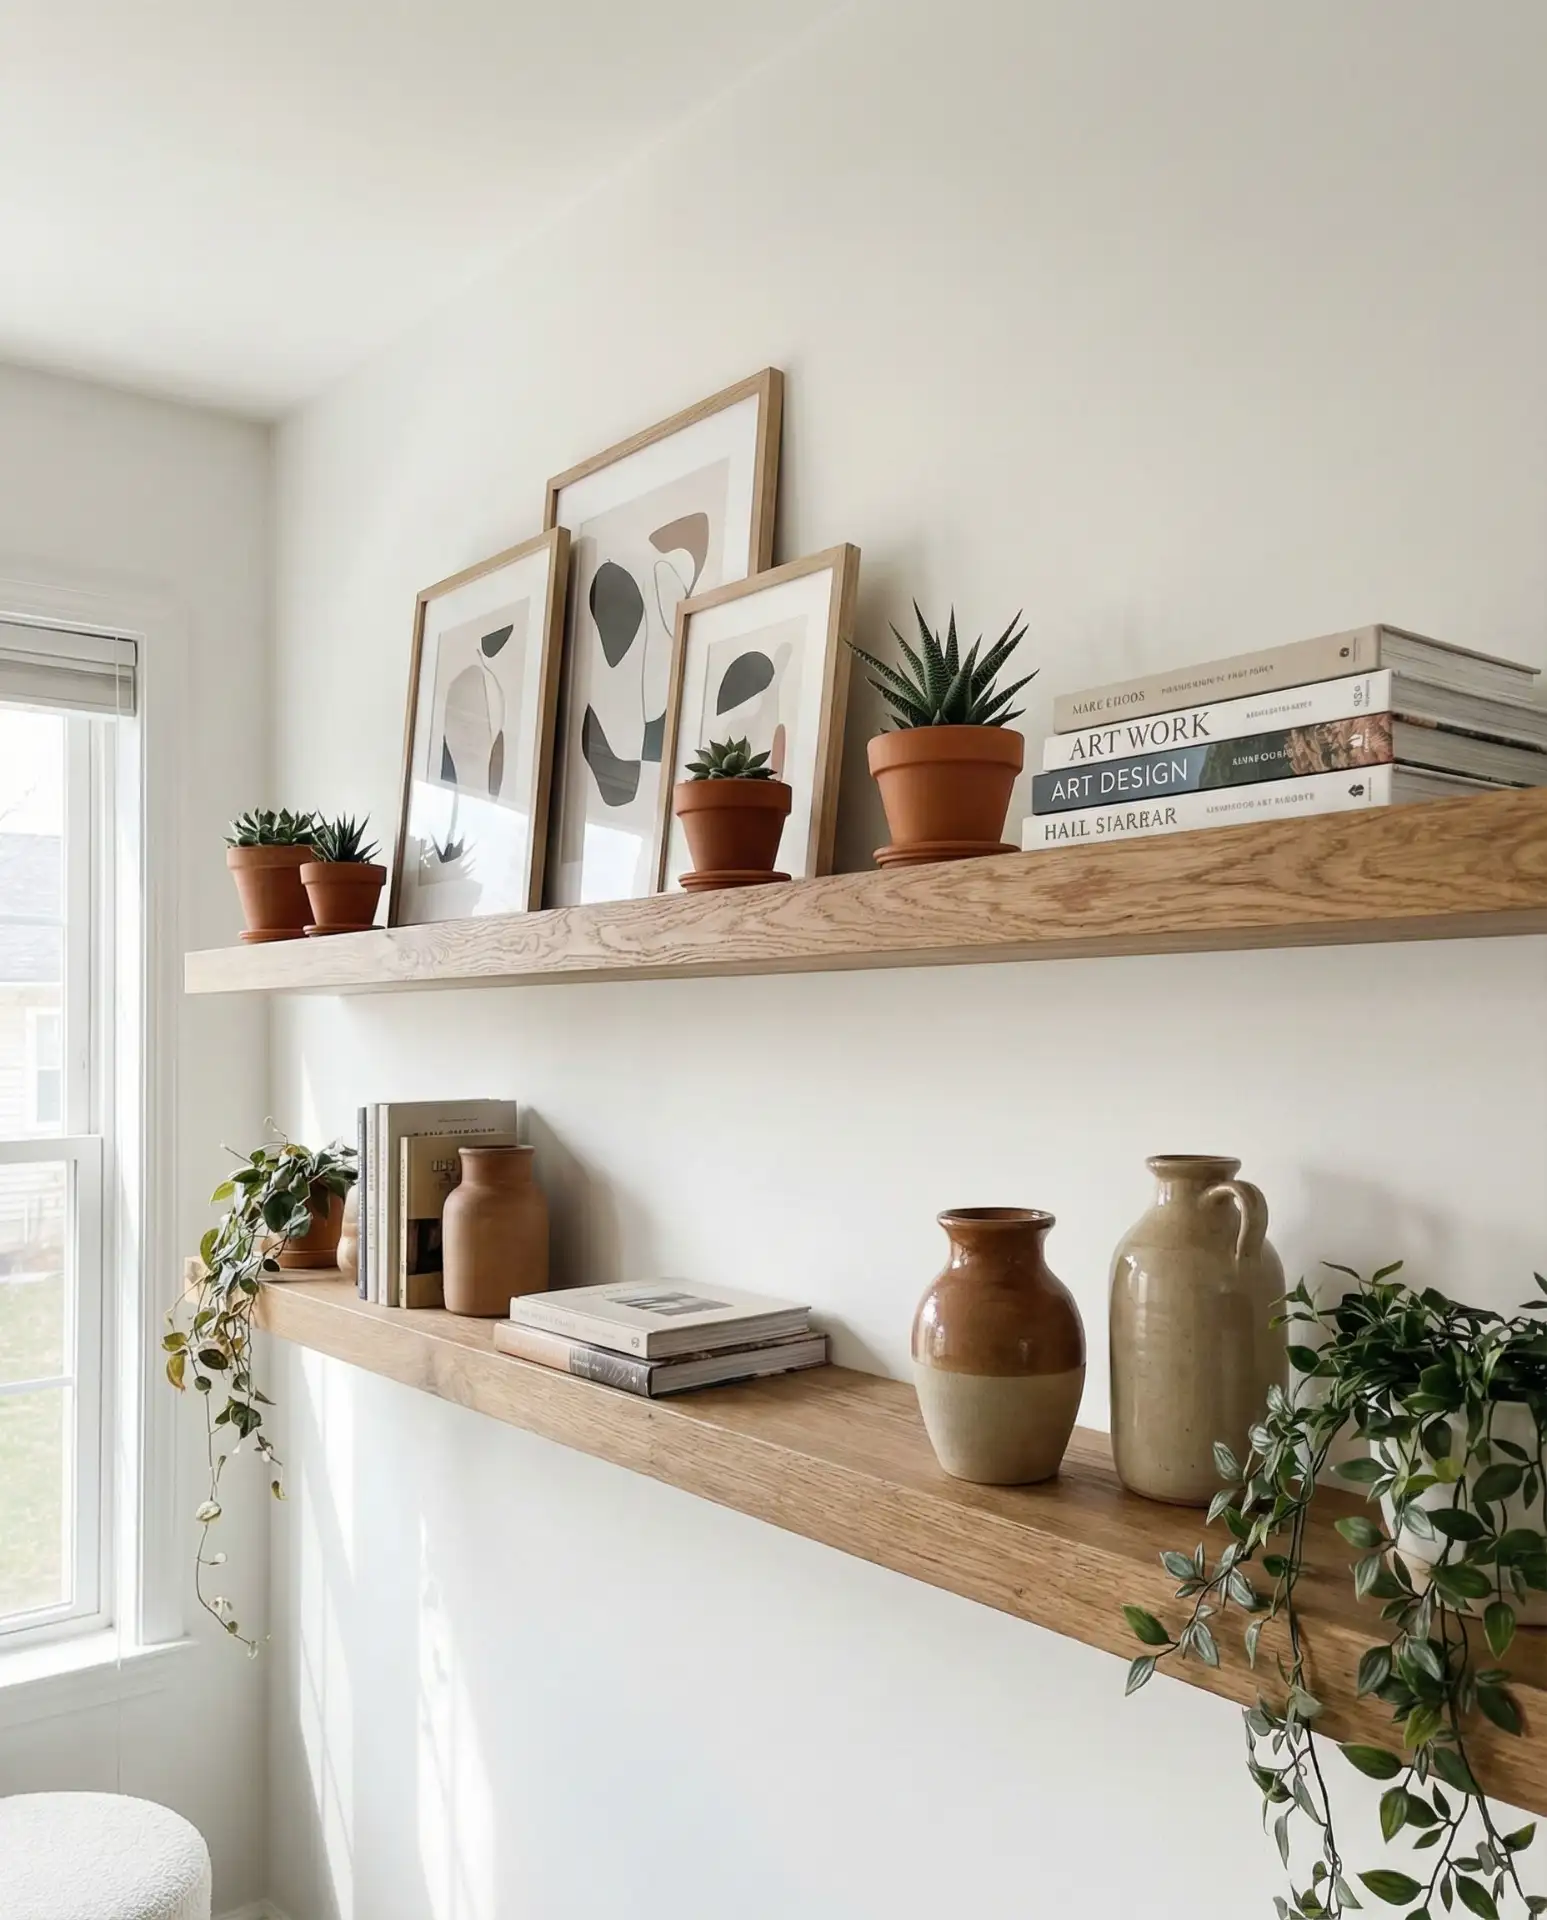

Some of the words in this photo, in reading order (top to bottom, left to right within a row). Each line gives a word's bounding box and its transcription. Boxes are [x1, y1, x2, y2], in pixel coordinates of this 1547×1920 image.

[1069, 729, 1121, 761] ART
[1126, 711, 1211, 749] WORK
[1051, 775, 1093, 802] ART
[1100, 758, 1188, 793] DESIGN
